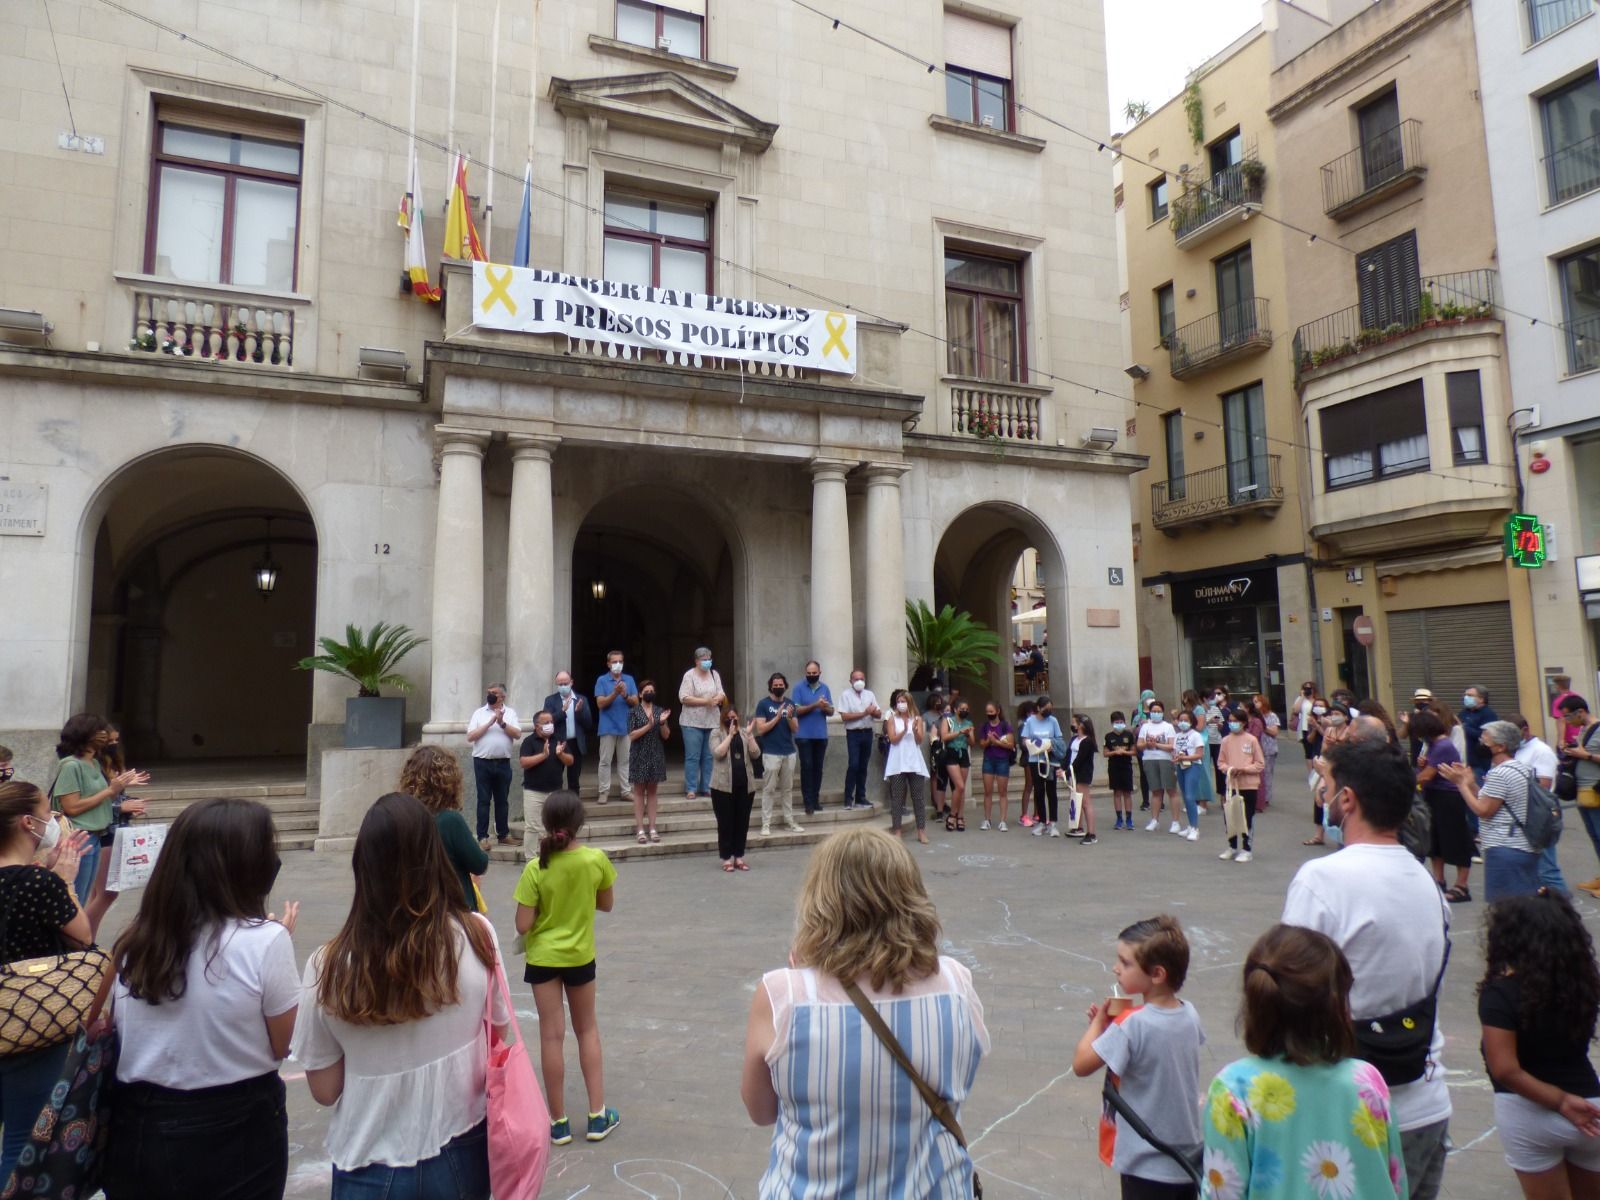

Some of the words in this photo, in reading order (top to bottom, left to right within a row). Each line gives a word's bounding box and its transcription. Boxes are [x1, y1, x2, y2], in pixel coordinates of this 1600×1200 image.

[705, 295, 810, 322] PRESES
[533, 298, 544, 322] I
[555, 299, 672, 341] PRESOS
[680, 322, 810, 357] POLÍTICS
[374, 543, 390, 555] 12
